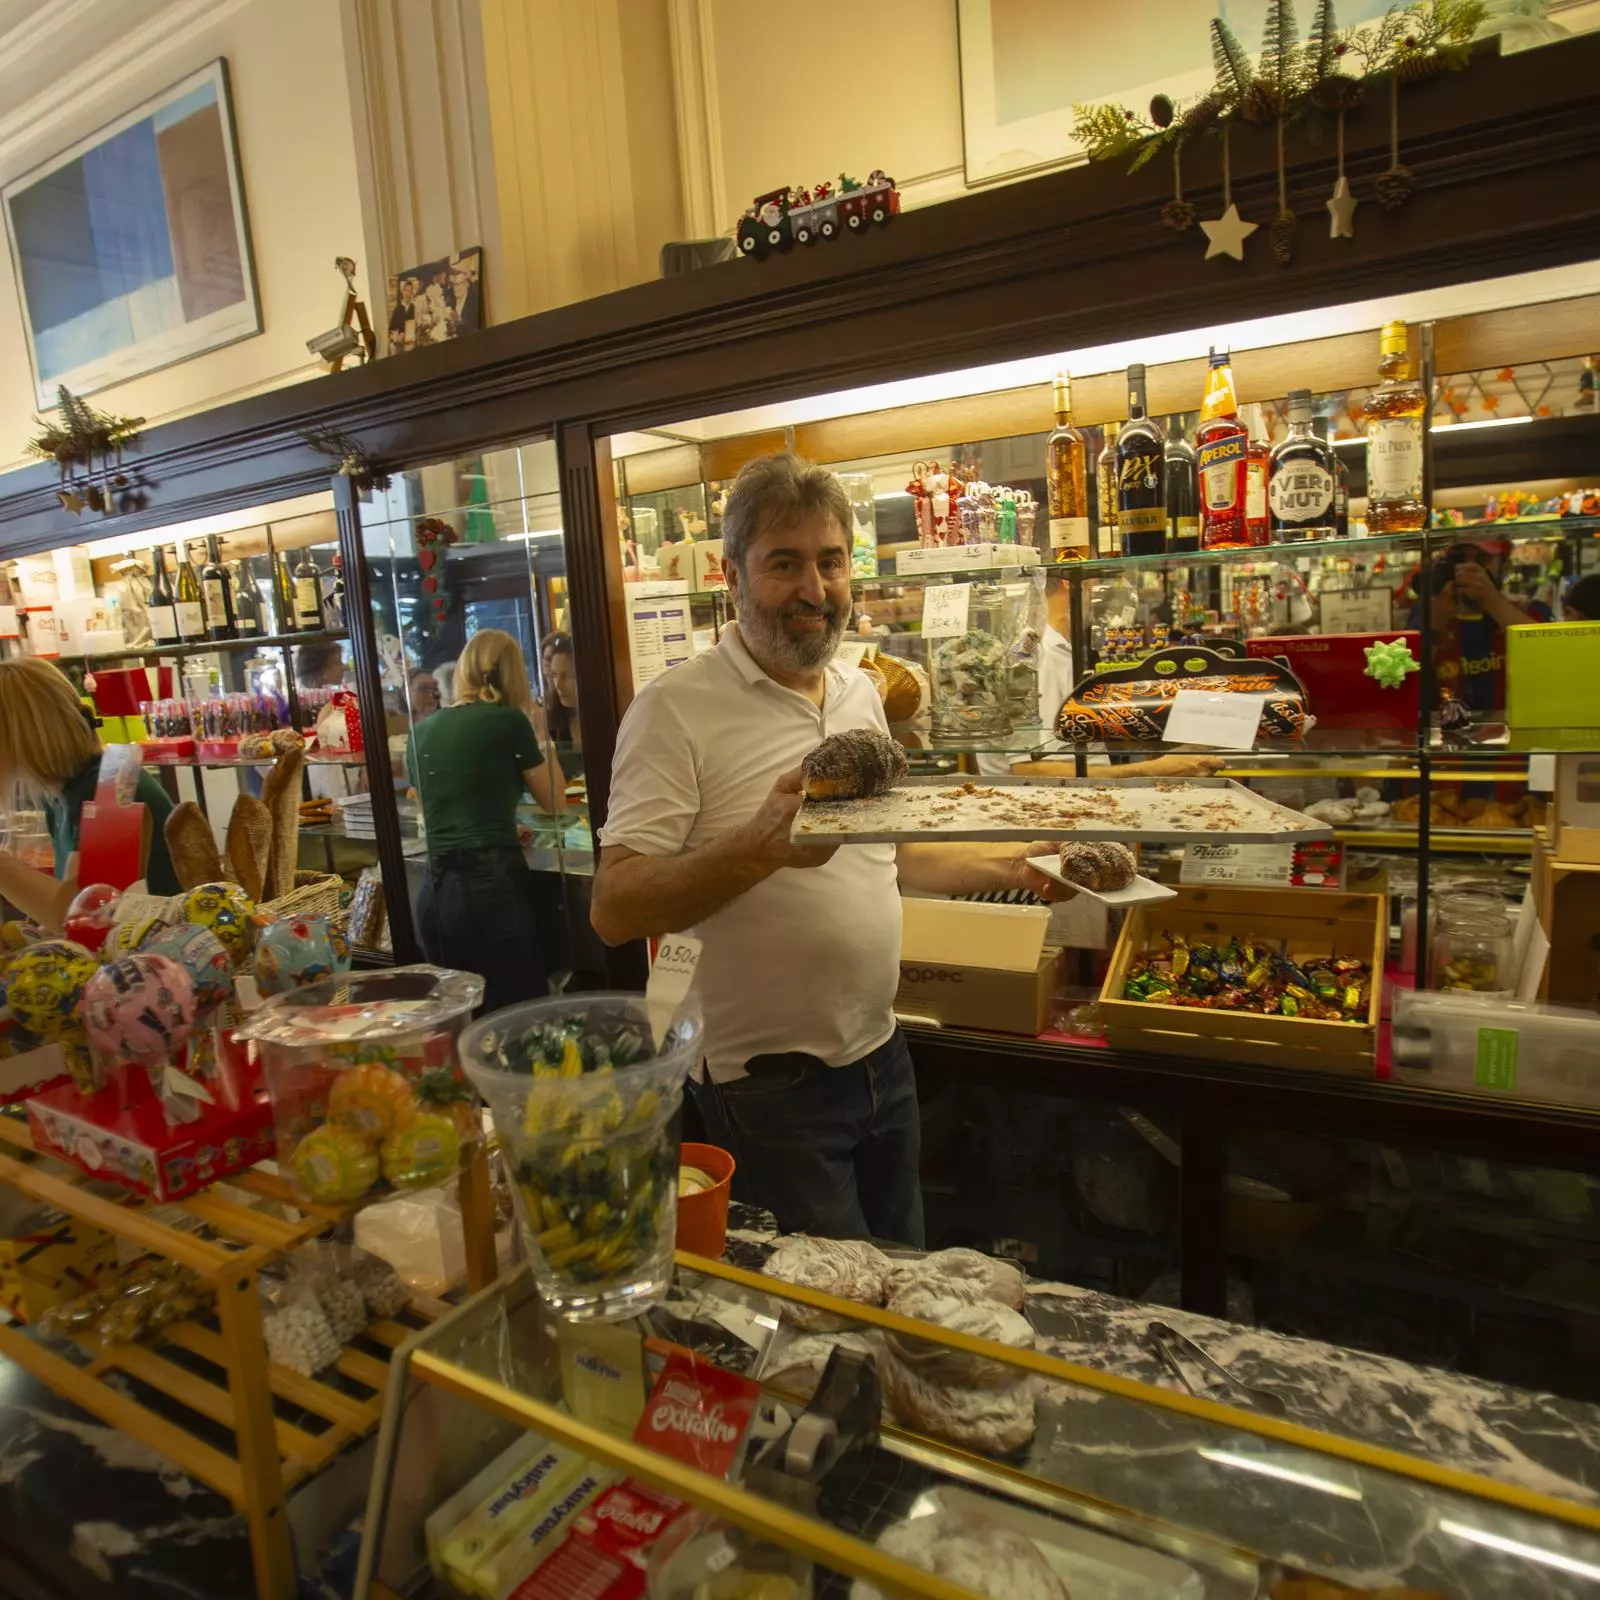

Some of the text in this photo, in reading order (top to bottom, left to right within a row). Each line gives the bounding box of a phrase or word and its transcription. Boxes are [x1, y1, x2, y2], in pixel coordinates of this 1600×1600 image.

[1199, 442, 1242, 467] APEROL
[1276, 474, 1322, 491] VER
[1279, 491, 1323, 510] MUT
[1565, 627, 1600, 637] GELA
